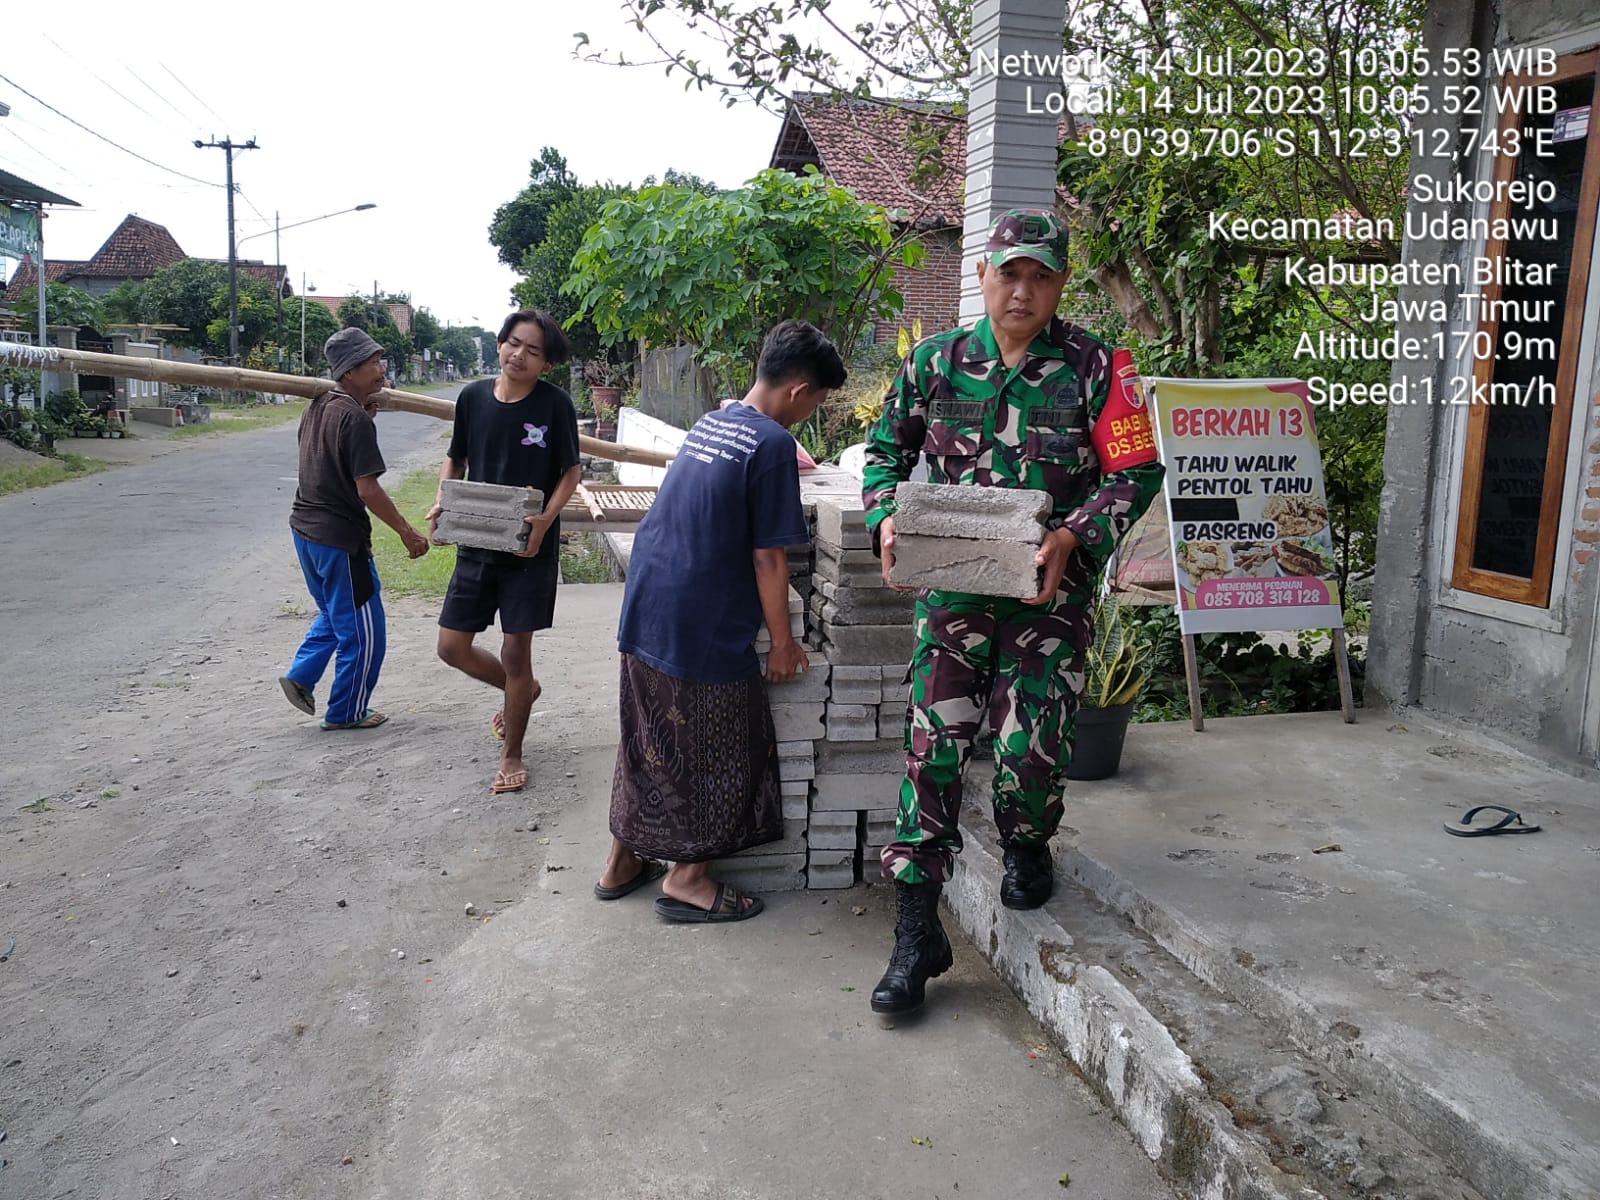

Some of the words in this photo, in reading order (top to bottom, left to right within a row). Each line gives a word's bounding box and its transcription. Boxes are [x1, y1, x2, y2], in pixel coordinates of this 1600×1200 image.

[1171, 408, 1270, 437] BERKAH
[1278, 408, 1303, 437] 13
[1173, 455, 1229, 473] TAHU
[1234, 455, 1297, 473] WALIK
[1177, 478, 1253, 496] PENTOL
[1260, 477, 1313, 495] TAHU
[1183, 522, 1276, 541] BASRENG
[1216, 582, 1262, 591] MENERIMA
[1204, 592, 1232, 607] 085
[1236, 591, 1265, 606] 708
[1268, 590, 1293, 605] 314
[1298, 589, 1320, 604] 128
